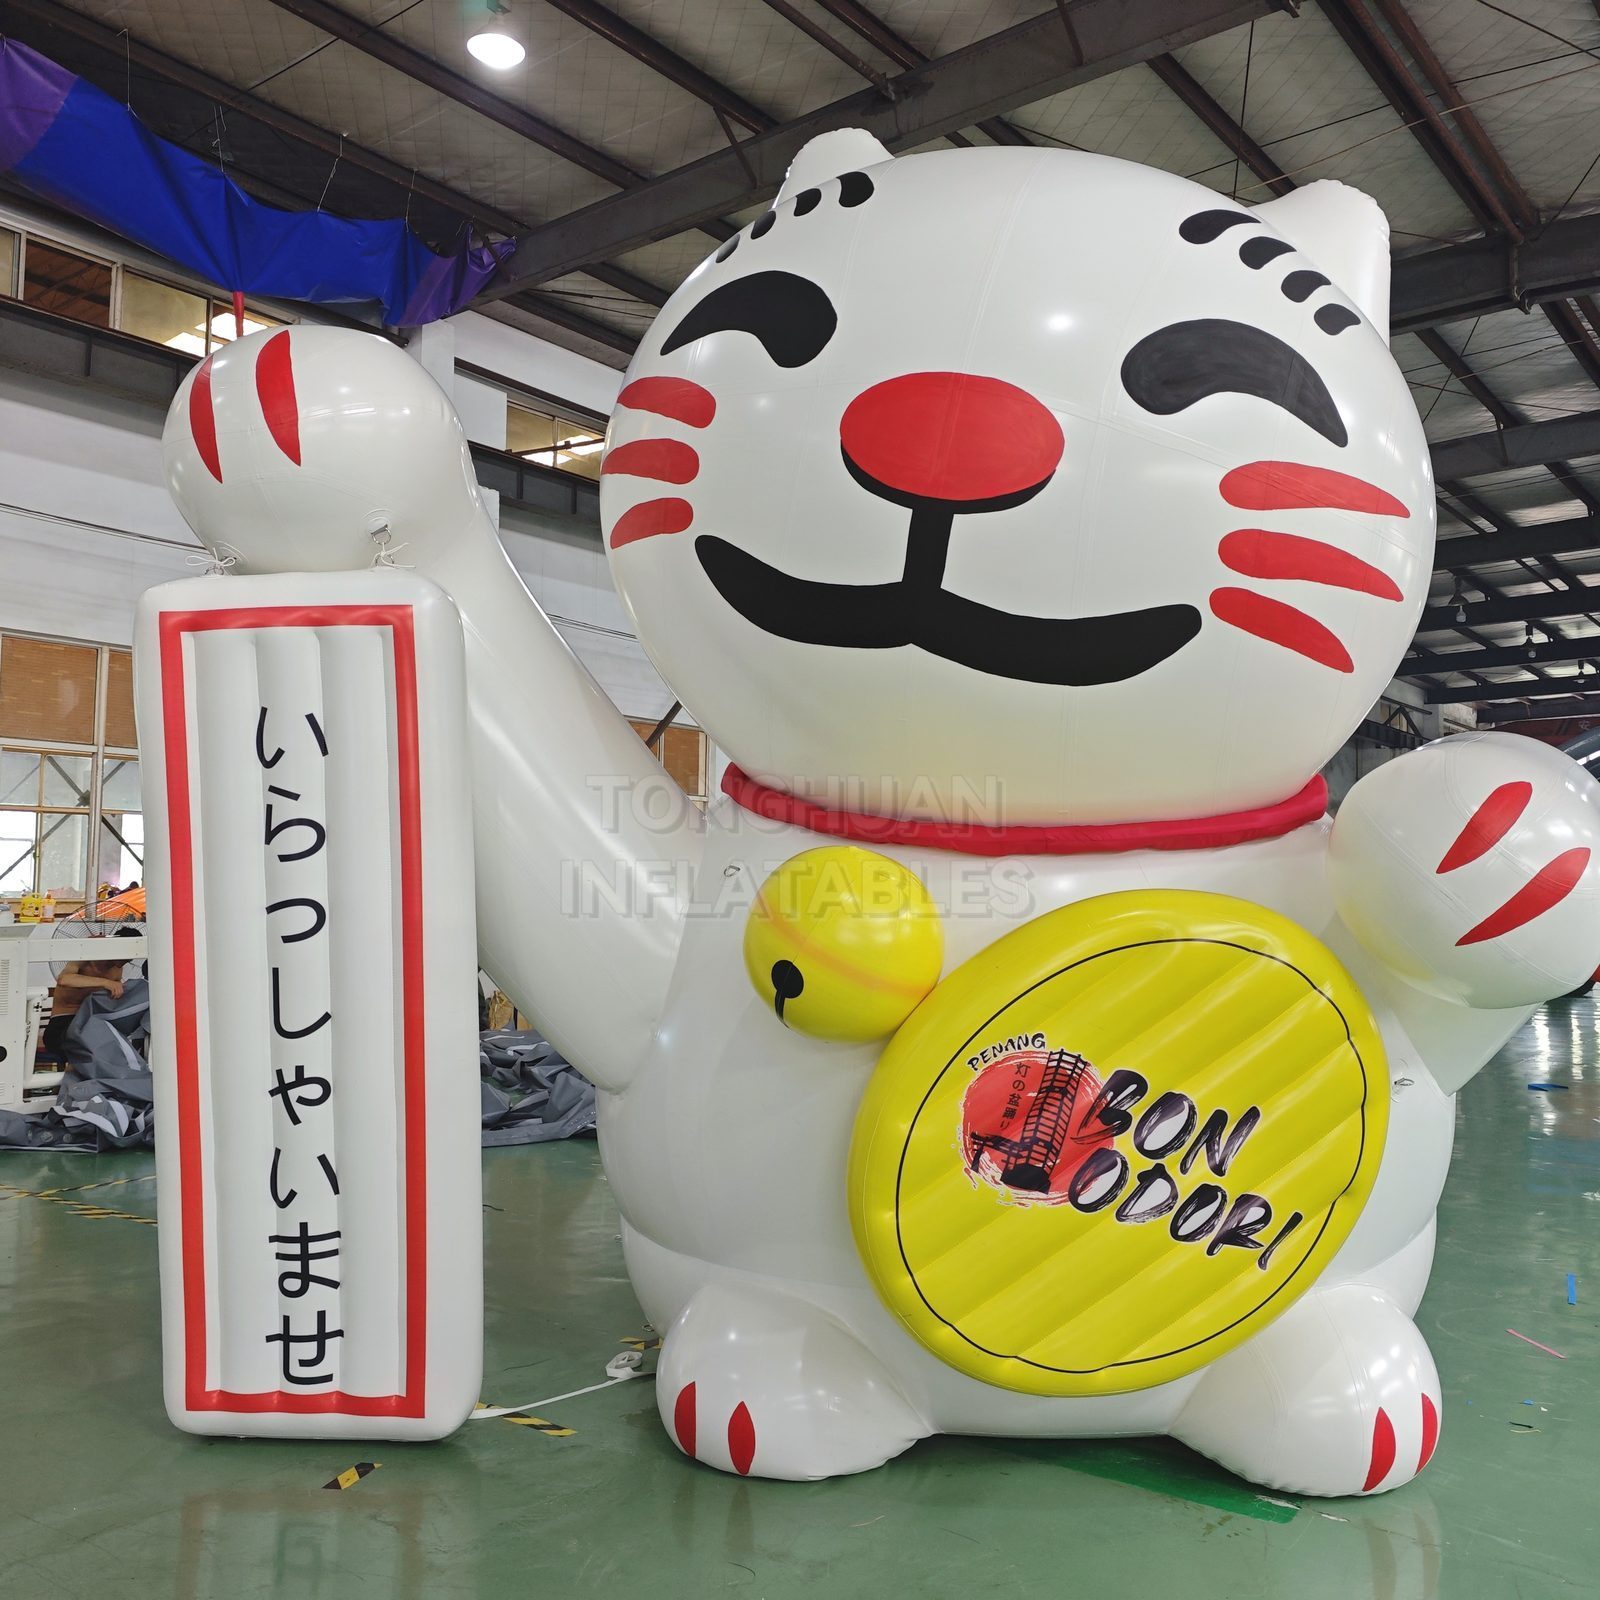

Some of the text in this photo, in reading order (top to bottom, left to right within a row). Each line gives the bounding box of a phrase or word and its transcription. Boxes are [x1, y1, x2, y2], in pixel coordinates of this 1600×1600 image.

[967, 1033, 1045, 1071] PENANG
[1070, 1069, 1260, 1177] BON
[1067, 1147, 1303, 1270] ODORI
